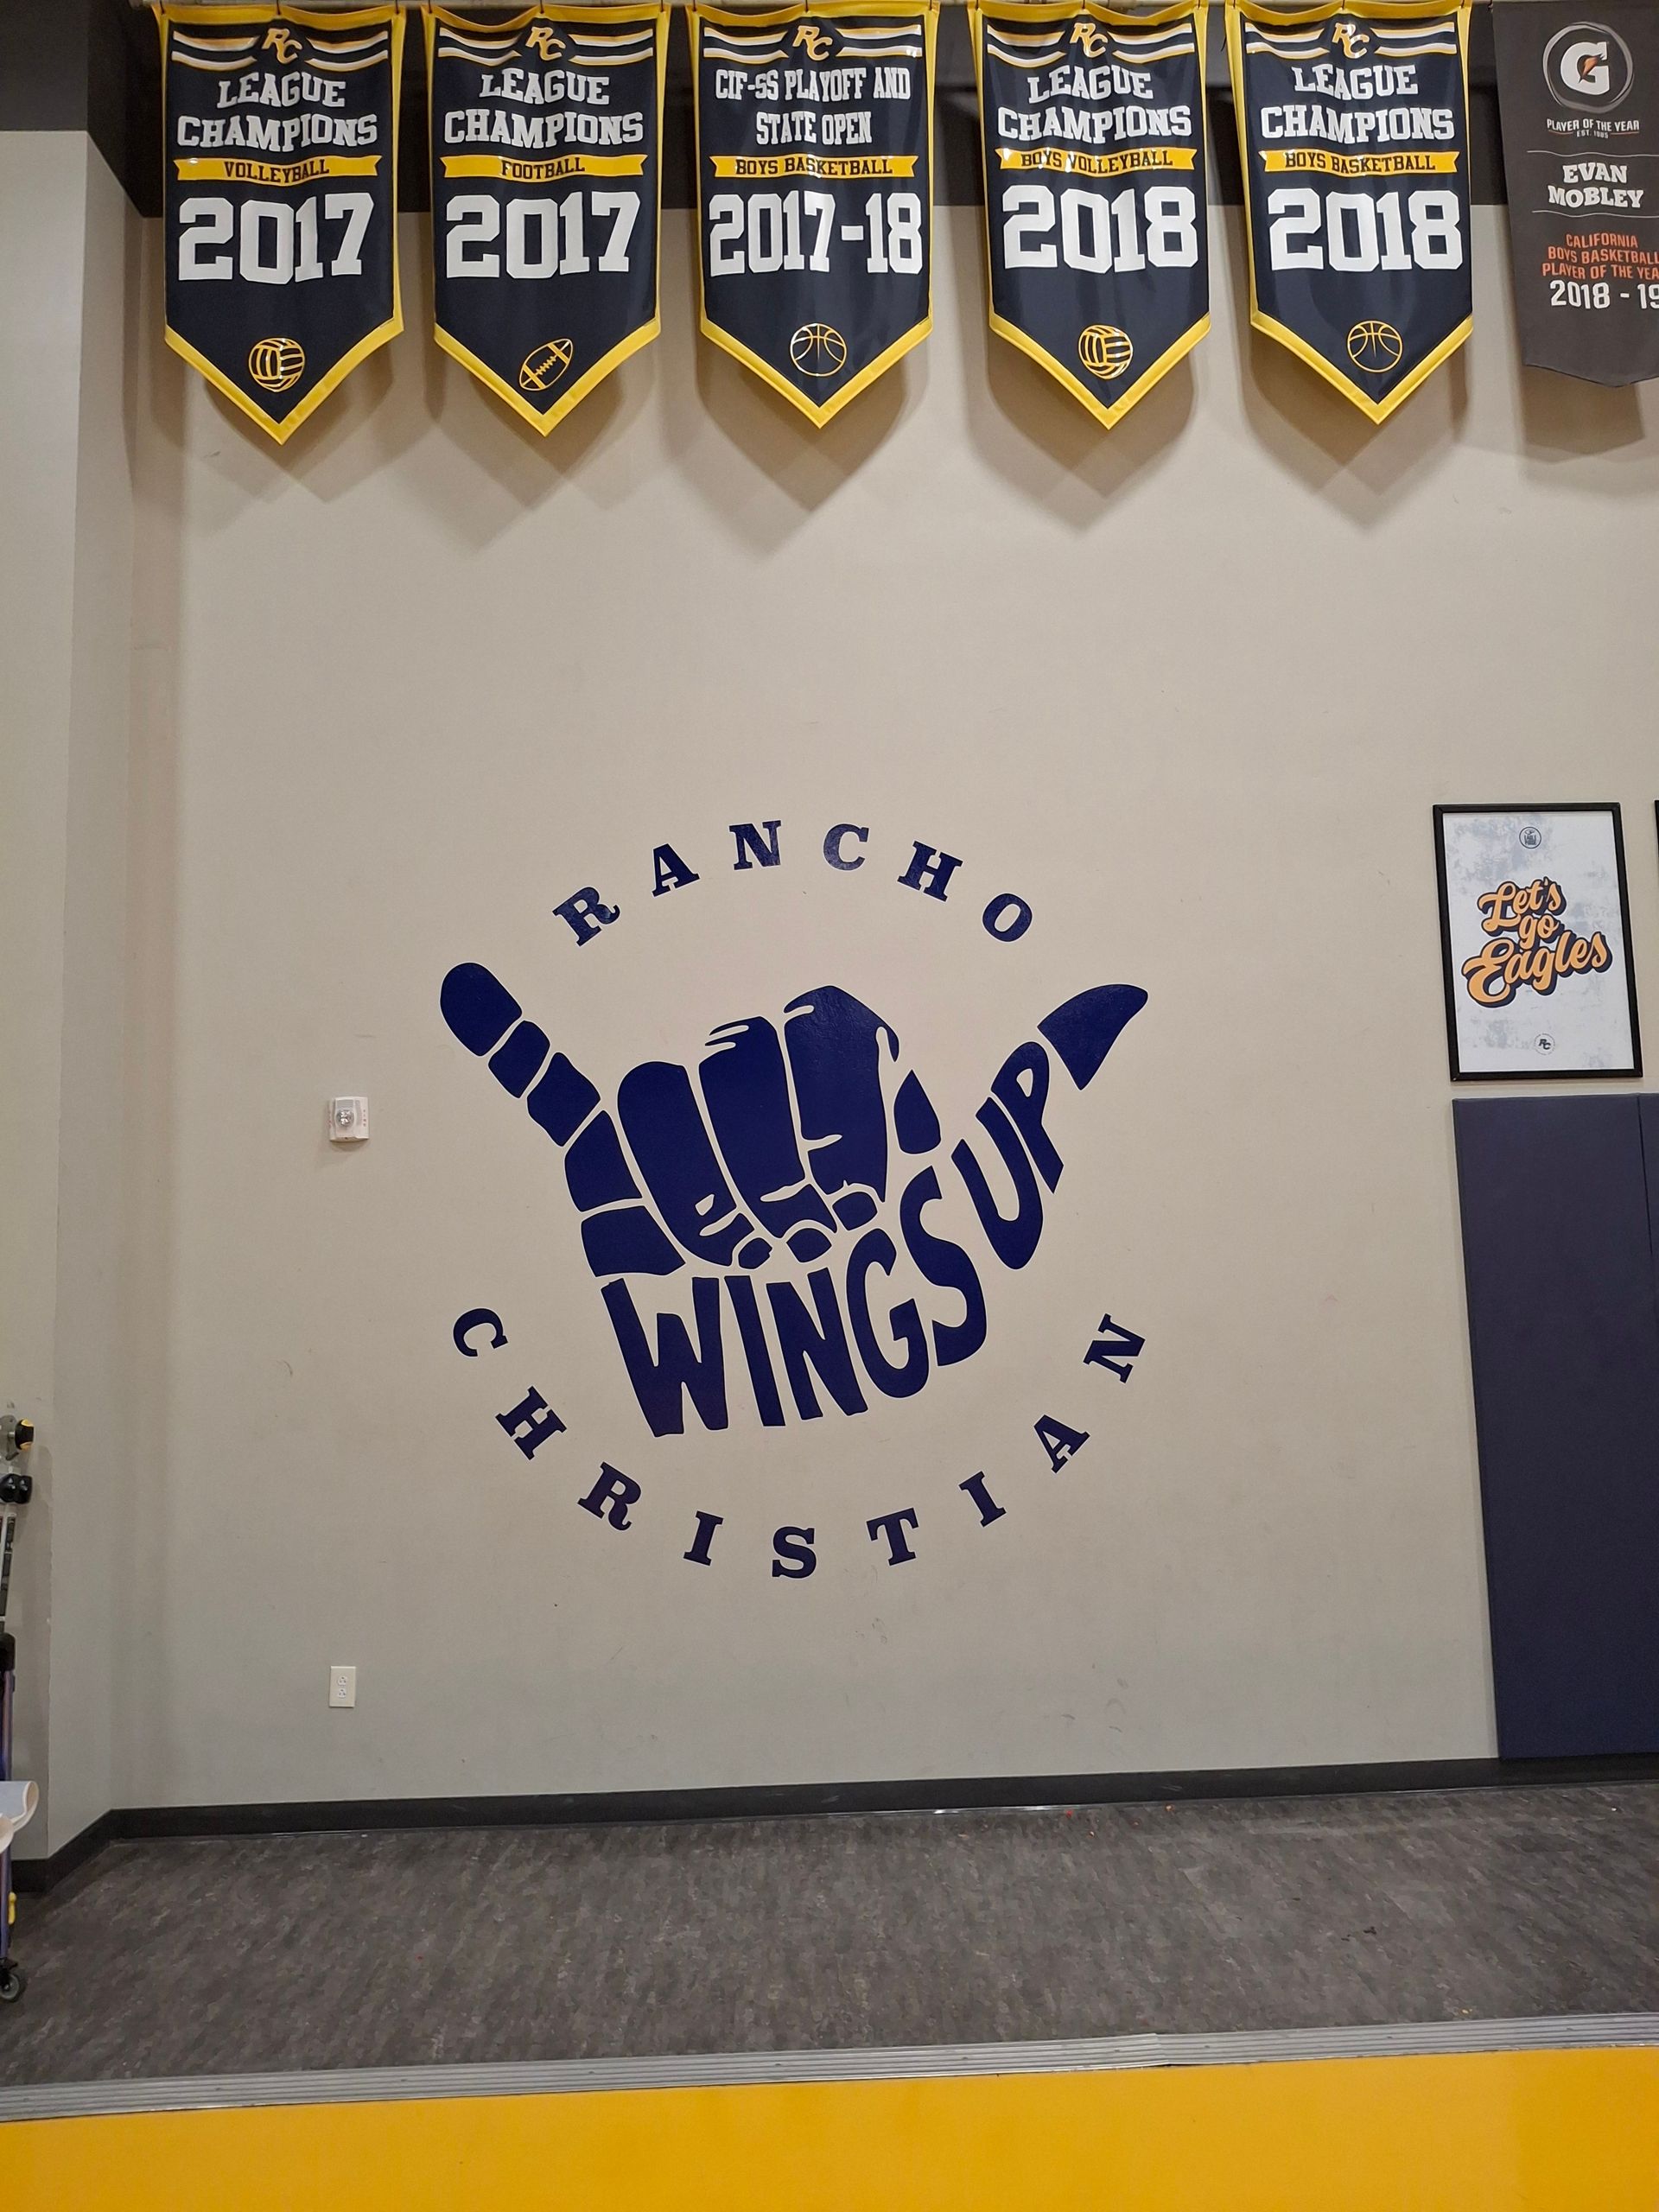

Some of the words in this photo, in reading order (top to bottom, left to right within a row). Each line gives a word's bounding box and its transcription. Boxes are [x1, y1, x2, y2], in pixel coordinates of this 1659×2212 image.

[262, 28, 302, 64] RC
[525, 26, 566, 61] RC
[792, 25, 832, 60] RC
[1070, 22, 1109, 58] RC
[1332, 22, 1370, 59] RC
[479, 67, 610, 105] LEAGUE
[715, 68, 779, 101] CIF-SS
[784, 67, 867, 102] PLAYOFF
[873, 67, 911, 99] AND
[1027, 65, 1154, 105] LEAGUE
[1291, 63, 1419, 101] LEAGUE
[1560, 41, 1610, 96] G
[217, 71, 346, 109] LEAGUE
[177, 113, 378, 152] CHAMPIONS
[444, 109, 644, 149] CHAMPIONS
[756, 111, 817, 145] STATE
[822, 111, 873, 145] OPEN
[997, 105, 1192, 144] CHAMPIONS
[1261, 105, 1455, 144] CHAMPIONS
[1547, 118, 1580, 132] PLAYER
[1582, 118, 1594, 129] OF
[1596, 120, 1612, 132] THE
[1614, 120, 1640, 132] YEAR
[224, 159, 330, 183] VOLLEYBALL
[501, 157, 586, 180] FOOTBALL
[735, 159, 779, 175] BOYS
[785, 156, 893, 175] BASKETBALL
[1020, 150, 1063, 167] BOYS
[1068, 150, 1173, 174] VOLLEYBALL
[1285, 151, 1326, 168] BOYS
[1332, 153, 1436, 174] BASKETBALL
[1562, 162, 1628, 184] EVAN
[1548, 185, 1644, 208] MOBLEY
[178, 192, 374, 285] 2017
[446, 191, 641, 279] 2017
[709, 190, 923, 276] 2017-18
[1002, 185, 1198, 274] 2018
[1268, 188, 1463, 272] 2018
[1566, 232, 1638, 248] CALIFORNIA
[1541, 262, 1586, 279] PLAYER
[1590, 264, 1606, 279] OF
[1611, 264, 1633, 279] THE
[1637, 266, 1659, 280] YEA
[1548, 245, 1578, 263] BOYS
[1581, 248, 1659, 264] BASKETBALL
[1549, 279, 1611, 309] 2018
[1637, 283, 1659, 309] 19
[553, 820, 1033, 946] RANCHO
[1477, 876, 1566, 935] Let's
[1518, 912, 1565, 950] go
[1461, 930, 1612, 1008] Eagles
[601, 1166, 988, 1438] WINGS
[951, 1041, 1065, 1270] UP
[453, 1308, 1146, 1579] CHRISTIAN
